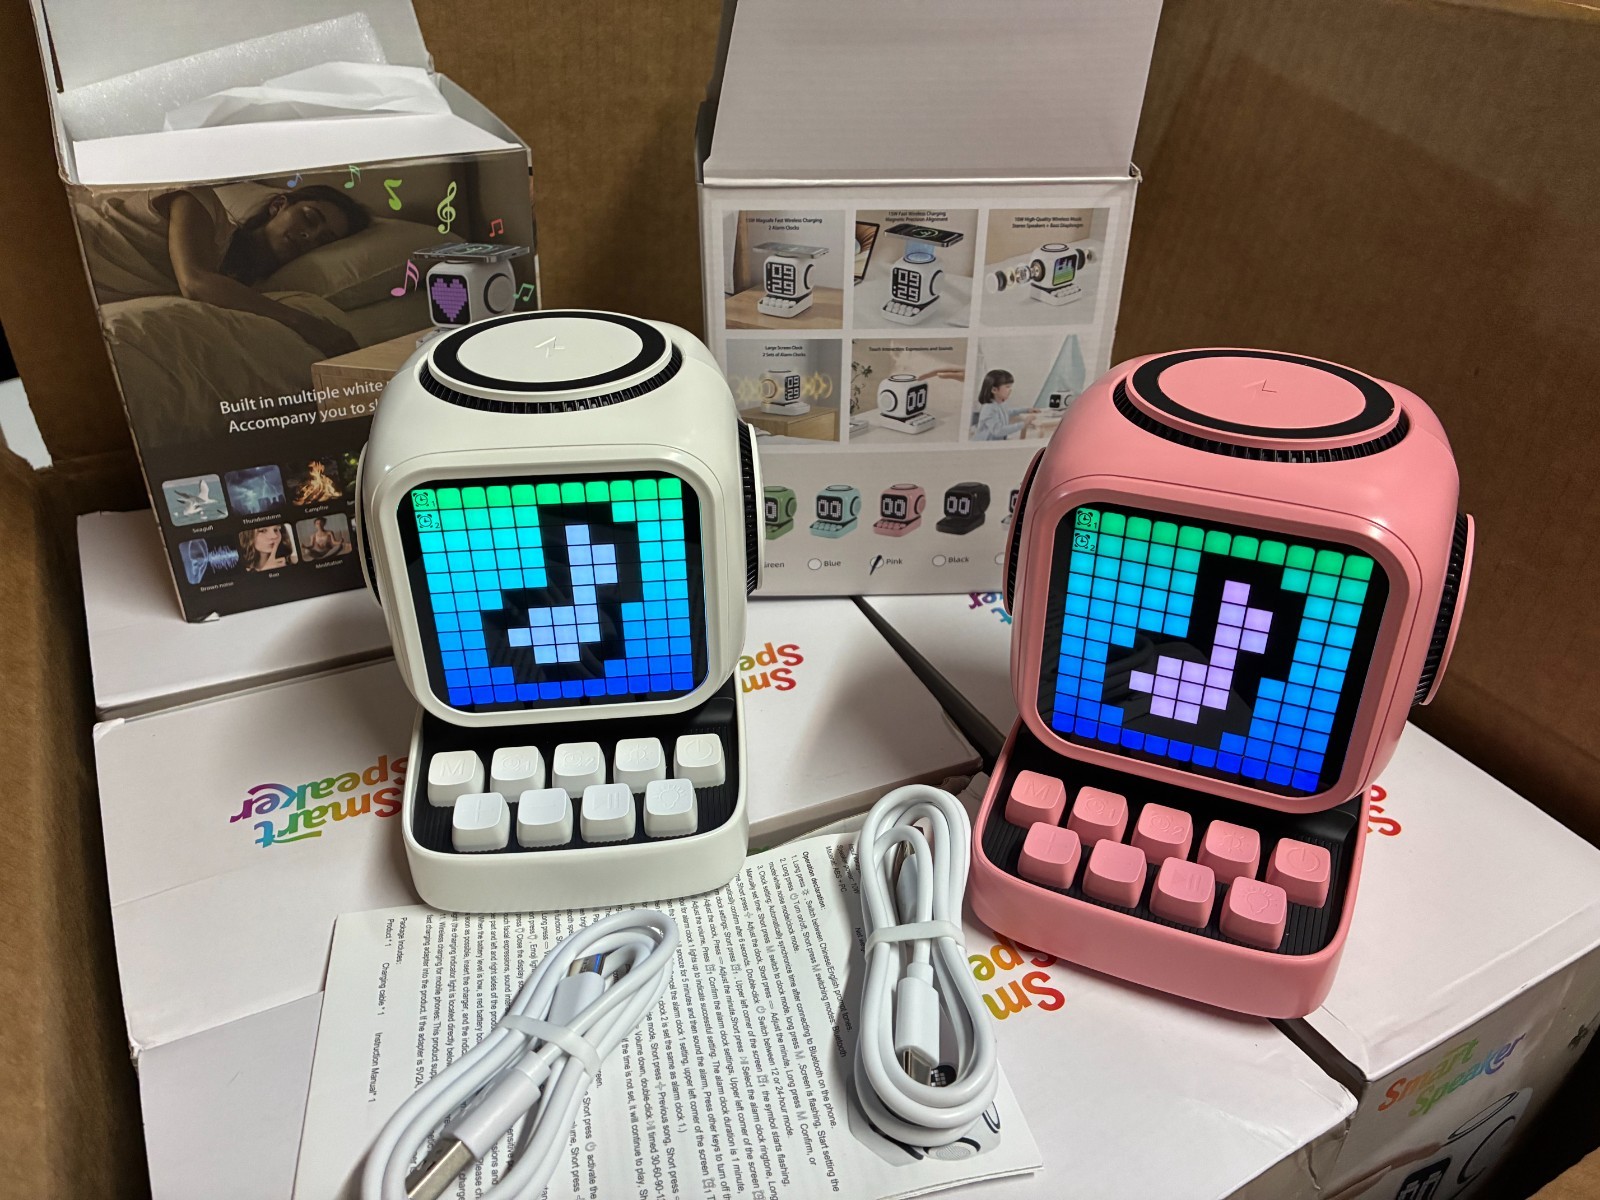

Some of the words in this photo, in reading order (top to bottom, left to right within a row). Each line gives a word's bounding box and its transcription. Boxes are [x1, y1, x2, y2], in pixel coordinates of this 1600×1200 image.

[220, 399, 257, 415] Built
[260, 397, 274, 409] in
[277, 386, 340, 407] multiple
[343, 381, 383, 397] white
[228, 410, 317, 434] Accompany
[319, 407, 347, 422] you
[351, 404, 365, 415] to
[824, 559, 841, 567] Blue
[439, 758, 466, 778] M
[1024, 780, 1050, 800] M
[253, 787, 403, 848] Smart
[801, 851, 815, 877] Operation
[810, 877, 826, 910] declaration:
[385, 918, 395, 940] Product
[397, 916, 408, 939] Package
[768, 905, 783, 940] Automatically
[777, 940, 792, 974] synchronize
[378, 962, 390, 989] Charging
[787, 973, 797, 988] time
[378, 989, 386, 1006] cable
[734, 979, 745, 998] Upper
[791, 987, 801, 1002] after
[657, 999, 667, 1016] clock
[740, 998, 749, 1009] left
[815, 972, 829, 1001] switching
[831, 1025, 846, 1056] Bluetooth
[742, 1009, 753, 1029] corner
[757, 1015, 769, 1037] Switch
[770, 1012, 782, 1032] Adjust
[796, 1002, 811, 1037] connecting
[662, 1028, 671, 1039] set
[749, 1038, 757, 1049] the
[775, 1032, 784, 1043] the
[806, 1037, 813, 1045] to
[371, 1032, 383, 1066] Instruction
[415, 1032, 426, 1058] adapter
[664, 1039, 672, 1051] the
[763, 1037, 775, 1066] between
[416, 1058, 424, 1066] is
[666, 1051, 675, 1070] same
[712, 1059, 721, 1074] The
[751, 1049, 763, 1073] screen
[778, 1044, 790, 1069] minute,
[808, 1045, 823, 1078] Bluetooth
[414, 1066, 426, 1090] 5V2A,
[669, 1070, 677, 1080] as
[770, 1066, 780, 1076] 12
[772, 1076, 781, 1084] or
[785, 1069, 796, 1088] Long
[1378, 1038, 1479, 1112] Smart
[1409, 1033, 1526, 1117] Speaker
[671, 1080, 680, 1101] alarm
[714, 1075, 725, 1095] alarm
[805, 1089, 814, 1097] is
[817, 1078, 826, 1089] on
[640, 1077, 653, 1120] double-click
[703, 1090, 713, 1112] Press
[719, 1096, 730, 1115] clock
[761, 1090, 770, 1102] the
[774, 1085, 788, 1113] 24-hour
[788, 1088, 801, 1109] press
[820, 1089, 830, 1102] the
[657, 1091, 669, 1124] Previous
[674, 1101, 685, 1121] clock
[763, 1103, 778, 1130] symbol
[808, 1097, 821, 1129] flashing,
[823, 1102, 837, 1129] phone.
[676, 1122, 688, 1133] 1.)
[707, 1113, 717, 1132] other
[723, 1116, 735, 1147] duration
[782, 1114, 794, 1138] mode.
[631, 1124, 641, 1157] continue
[662, 1124, 672, 1146] song,
[710, 1133, 721, 1152] keys
[771, 1131, 782, 1152] starts
[799, 1123, 813, 1155] Confirm,
[817, 1130, 829, 1149] Start
[634, 1157, 643, 1167] to
[665, 1146, 677, 1169] Short
[714, 1153, 723, 1162] to
[808, 1156, 817, 1166] or
[822, 1150, 835, 1177] setting
[586, 1154, 597, 1185] activate
[634, 1167, 646, 1188] play,
[716, 1162, 726, 1180] turn
[732, 1164, 745, 1194] minute,
[589, 1185, 598, 1200] the
[667, 1170, 679, 1194] press
[720, 1180, 731, 1192] off
[830, 1178, 840, 1192] the
